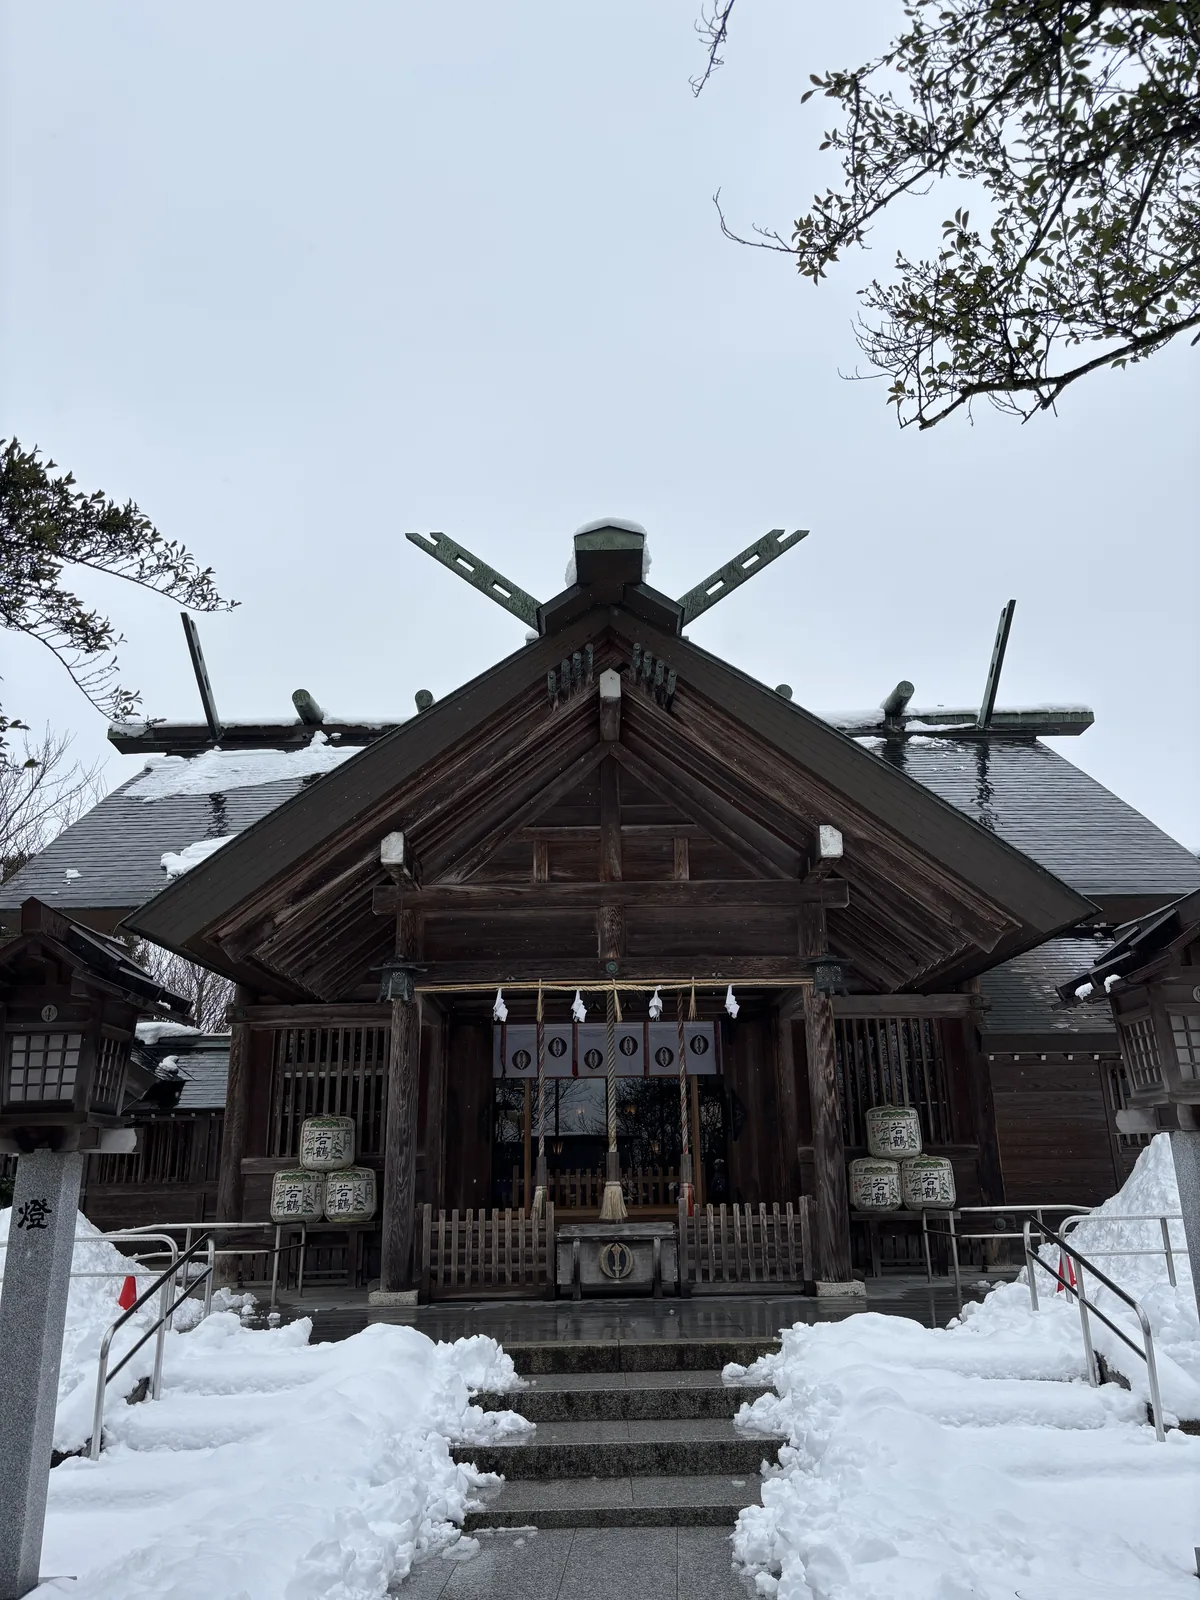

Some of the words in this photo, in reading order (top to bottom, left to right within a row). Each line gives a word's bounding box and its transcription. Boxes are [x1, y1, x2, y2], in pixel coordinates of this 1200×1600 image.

[313, 1131, 331, 1160] 若鶴
[890, 1121, 908, 1149] 若鶴
[284, 1184, 302, 1213] 若鶴
[335, 1184, 353, 1212] 若鶴
[872, 1177, 890, 1205] 若鶴
[922, 1171, 940, 1200] 若鶴
[17, 1198, 52, 1231] 燈
